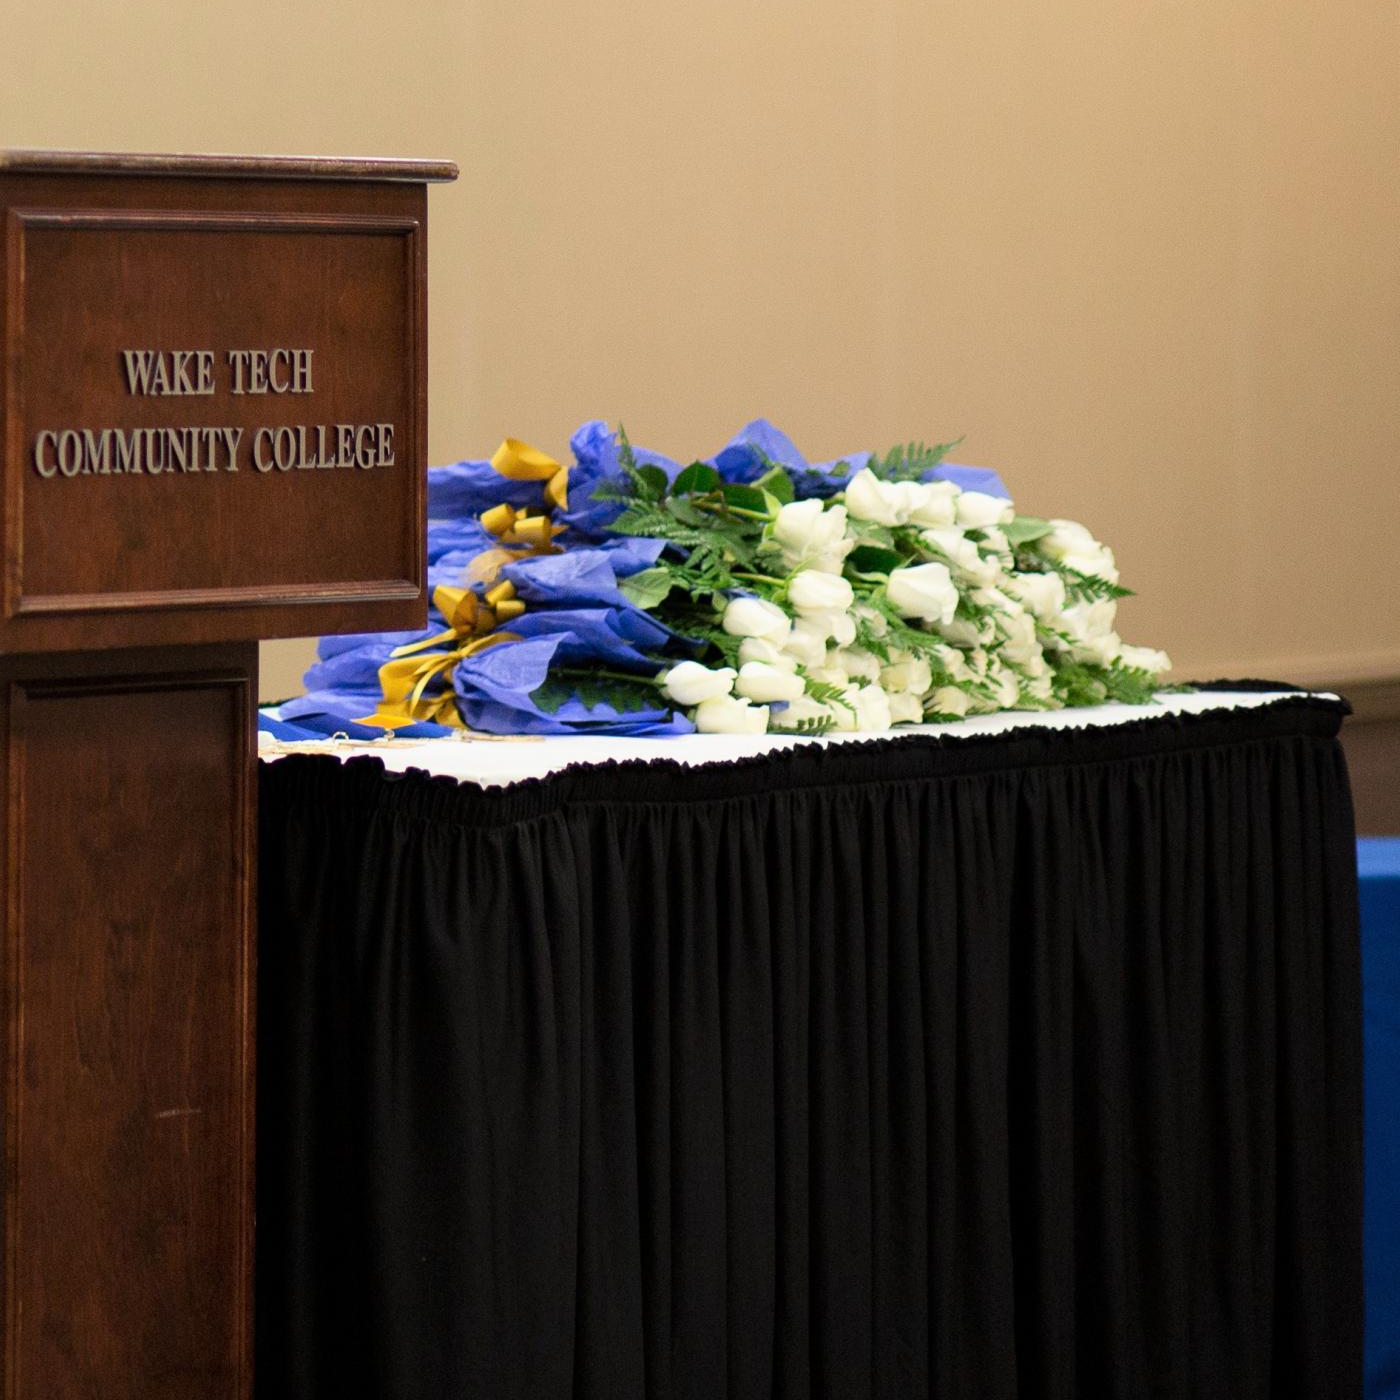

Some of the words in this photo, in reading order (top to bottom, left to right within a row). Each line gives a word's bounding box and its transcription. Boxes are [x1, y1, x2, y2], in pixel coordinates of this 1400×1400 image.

[123, 350, 215, 396] WAKE
[229, 348, 315, 395] TECH
[34, 427, 244, 478] COMMUNITY
[253, 424, 395, 473] COLLEGE
